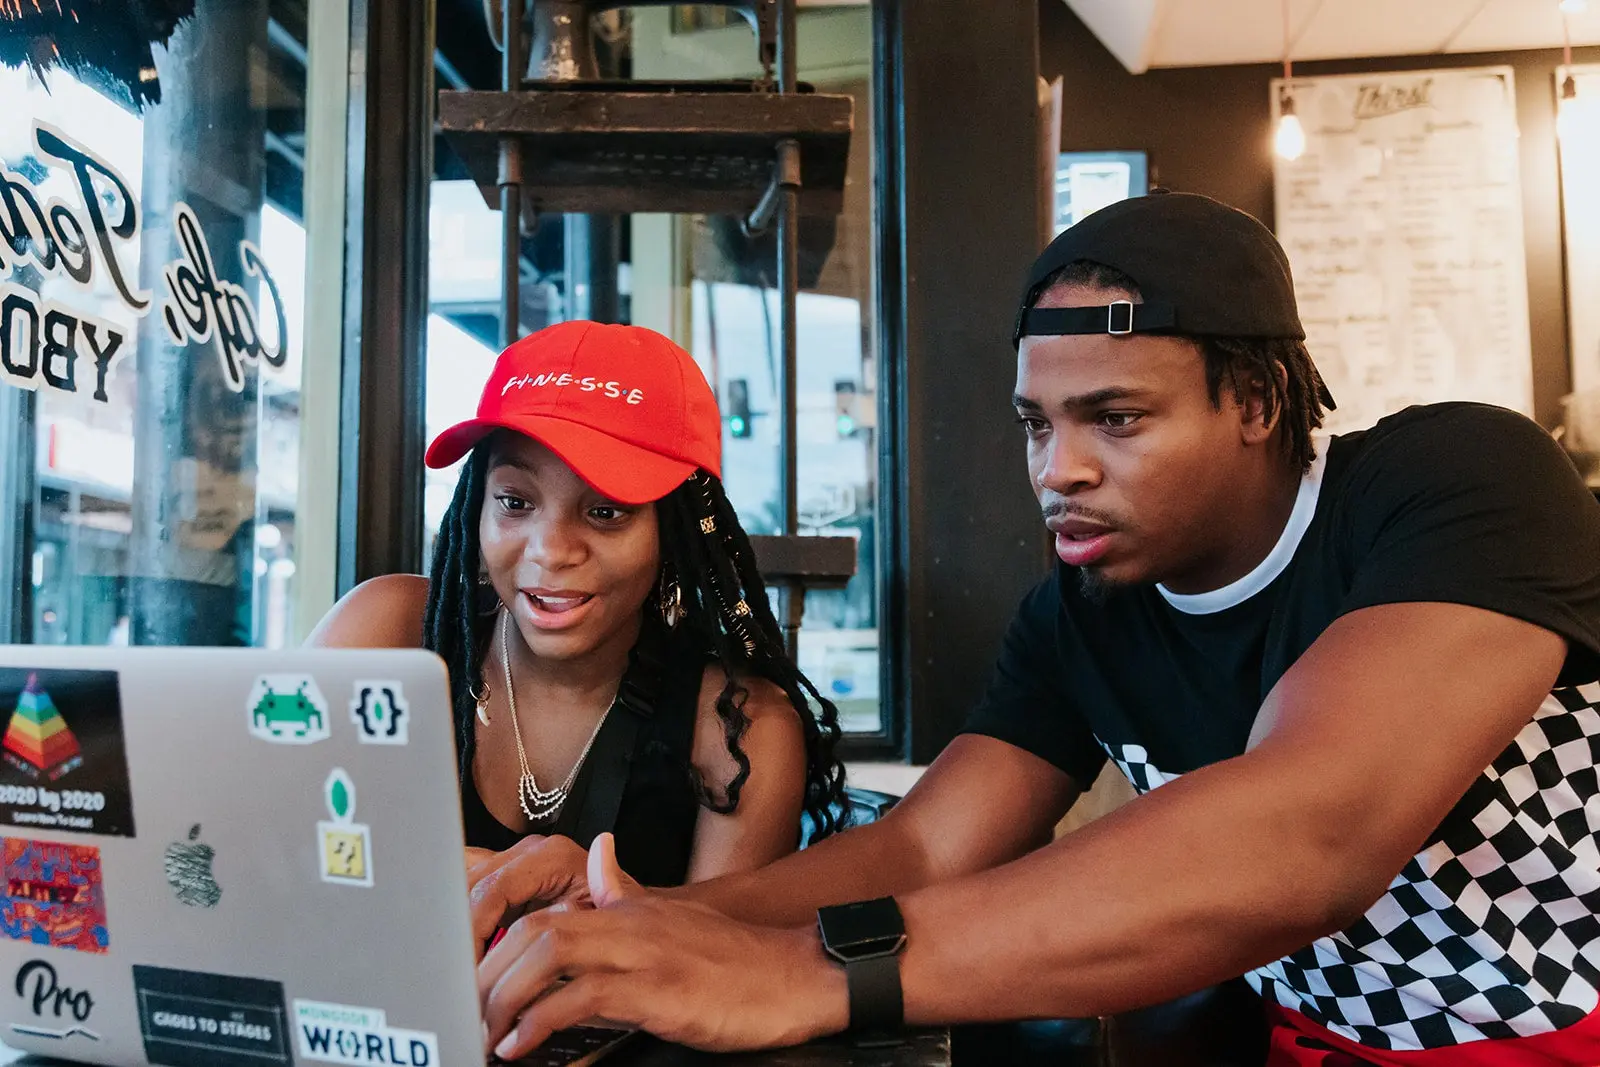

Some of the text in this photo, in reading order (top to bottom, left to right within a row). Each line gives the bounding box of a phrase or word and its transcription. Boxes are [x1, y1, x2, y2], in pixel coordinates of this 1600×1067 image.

[38, 786, 61, 813] by
[61, 789, 106, 811] 2020
[15, 959, 95, 1022] Pro
[198, 1017, 218, 1034] TO
[219, 1020, 272, 1042] STAGES
